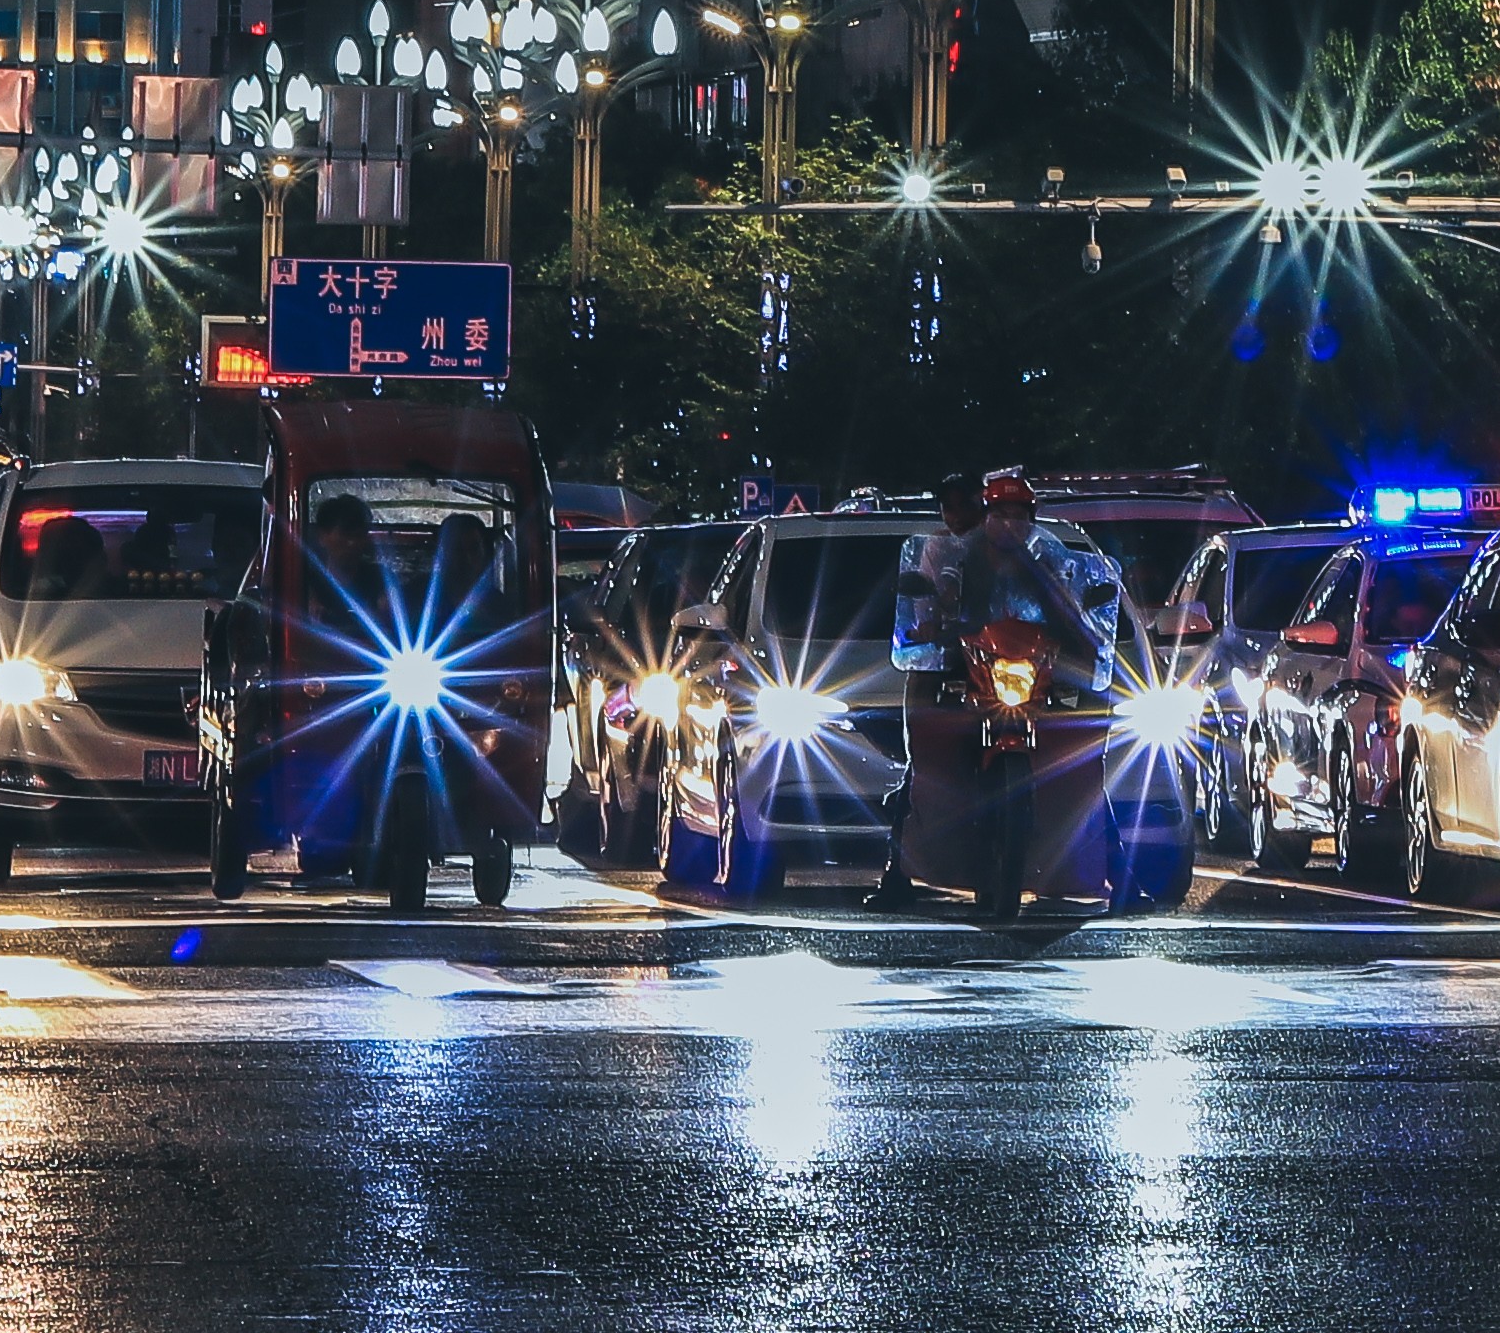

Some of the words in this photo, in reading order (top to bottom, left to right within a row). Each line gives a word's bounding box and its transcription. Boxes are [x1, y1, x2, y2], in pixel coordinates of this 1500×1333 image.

[318, 265, 398, 300] 大十字
[329, 302, 343, 314] Da
[348, 303, 366, 315] shi
[371, 304, 382, 315] zi
[429, 355, 457, 367] Zhou
[743, 481, 759, 511] P
